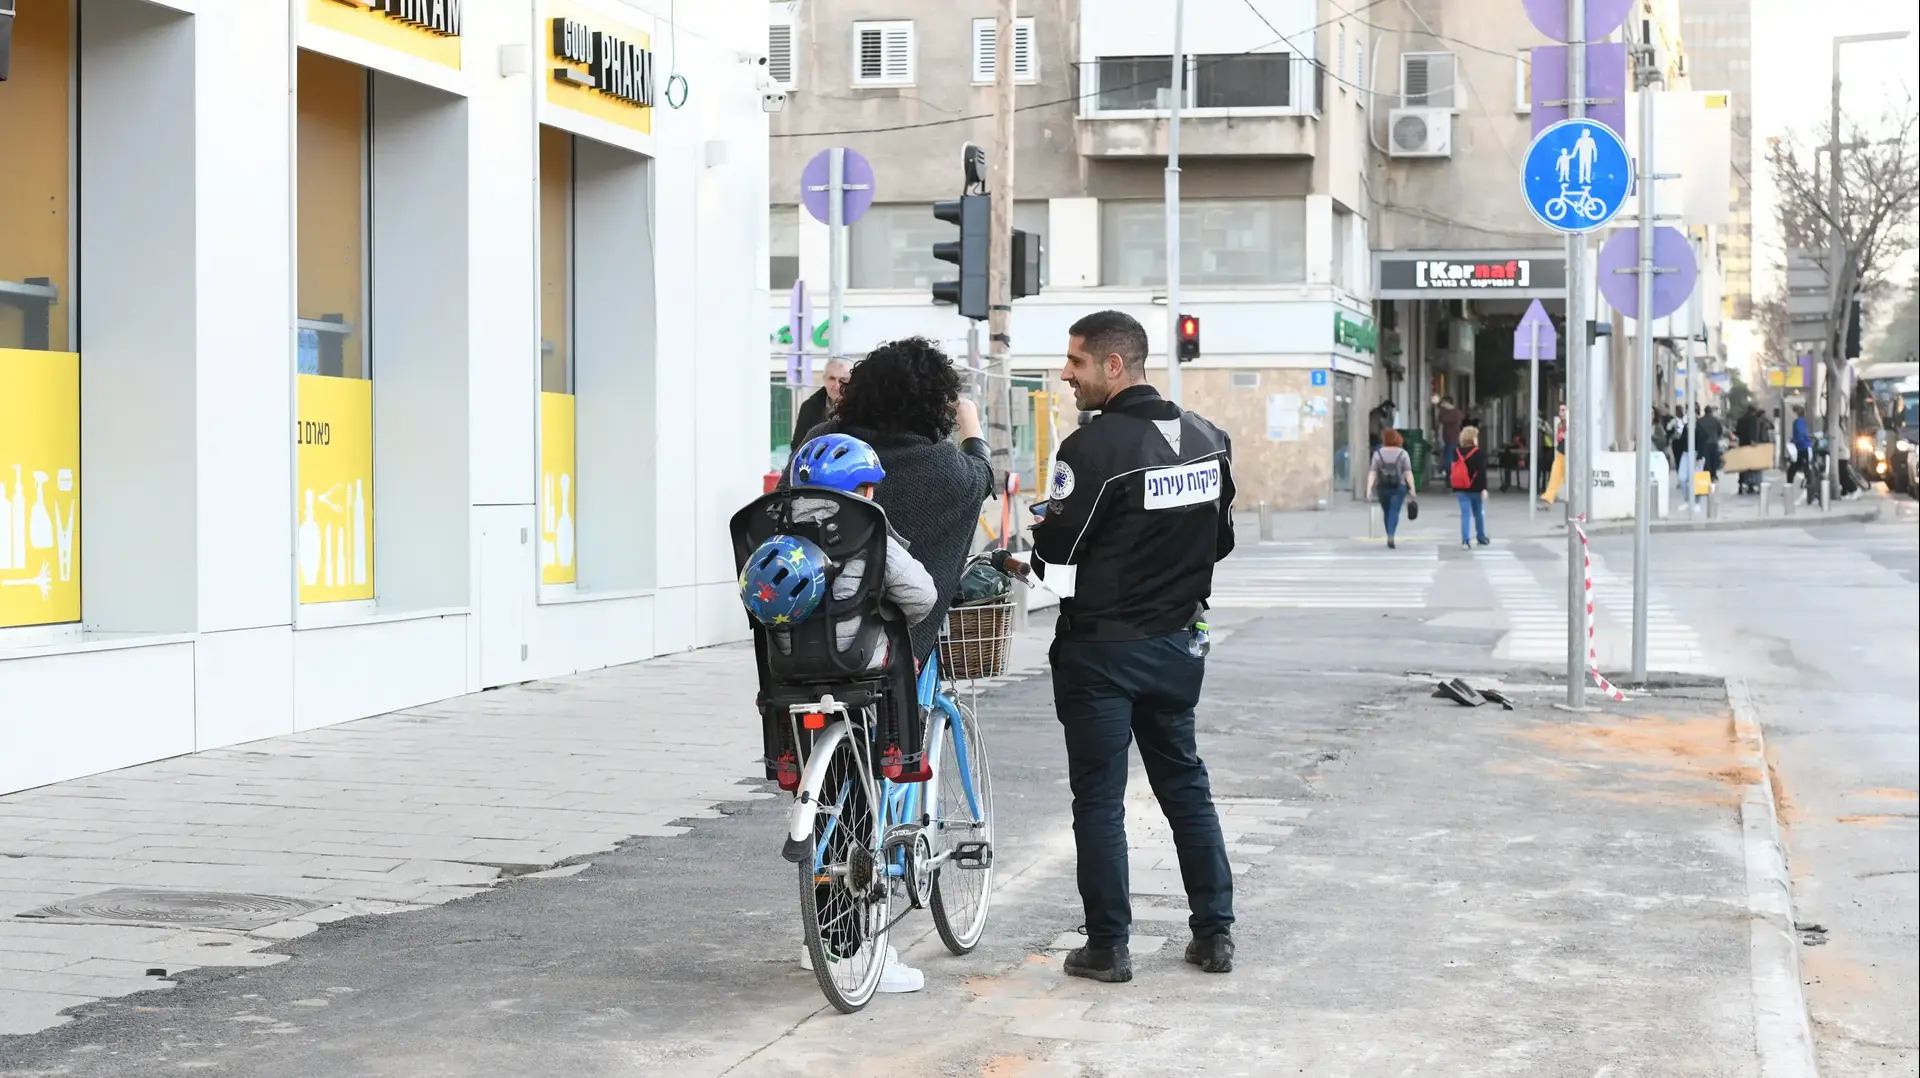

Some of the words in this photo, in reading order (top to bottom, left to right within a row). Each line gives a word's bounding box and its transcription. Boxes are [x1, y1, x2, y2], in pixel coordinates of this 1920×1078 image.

[563, 17, 593, 65] GOOD
[601, 32, 654, 107] PHARM
[305, 421, 330, 445] פארם
[1148, 474, 1184, 497] עירוני
[1186, 468, 1219, 495] פיקוח
